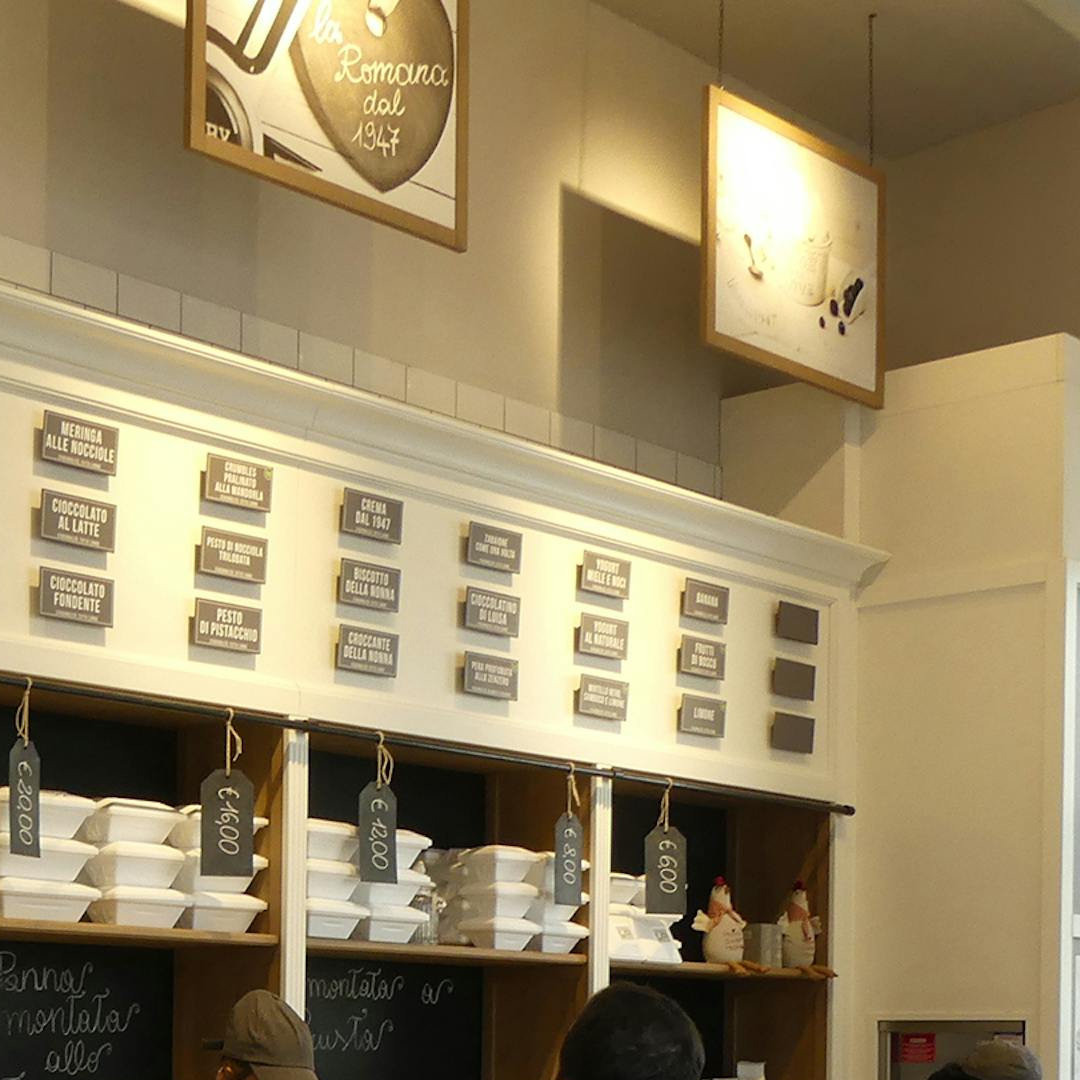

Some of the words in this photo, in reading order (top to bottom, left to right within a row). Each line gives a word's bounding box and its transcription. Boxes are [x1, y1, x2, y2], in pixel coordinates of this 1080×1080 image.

[334, 44, 449, 88] Romana
[363, 88, 406, 116] dal
[351, 121, 400, 158] 1947
[60, 420, 103, 444] MERINGA
[45, 433, 69, 454] ALLE
[70, 440, 115, 465] NOCCIOLE
[214, 482, 231, 494] ALLA
[52, 498, 108, 524] CIOCCOLATO
[360, 497, 387, 516] CREMA
[57, 516, 70, 532] AL
[72, 519, 100, 538] LATTE
[355, 510, 370, 525] DAL
[372, 514, 392, 531] 1947
[206, 536, 226, 550] PESTO
[49, 575, 105, 599] CIOCCOLATO
[345, 580, 370, 597] DELLA
[353, 566, 390, 587] BISCOTTO
[53, 592, 101, 615] FONDENTE
[216, 608, 244, 625] PESTO
[199, 620, 210, 635] DI
[210, 622, 258, 643] PISTACCHIO
[348, 631, 392, 651] CROCCANTE
[343, 644, 368, 661] DELLA
[17, 785, 34, 846] 20,00
[216, 802, 241, 857] 16,00
[370, 817, 389, 871] 12,00
[658, 855, 678, 895] 6,00
[309, 967, 405, 1001] montata
[421, 978, 454, 1005] a
[6, 987, 141, 1036] montata
